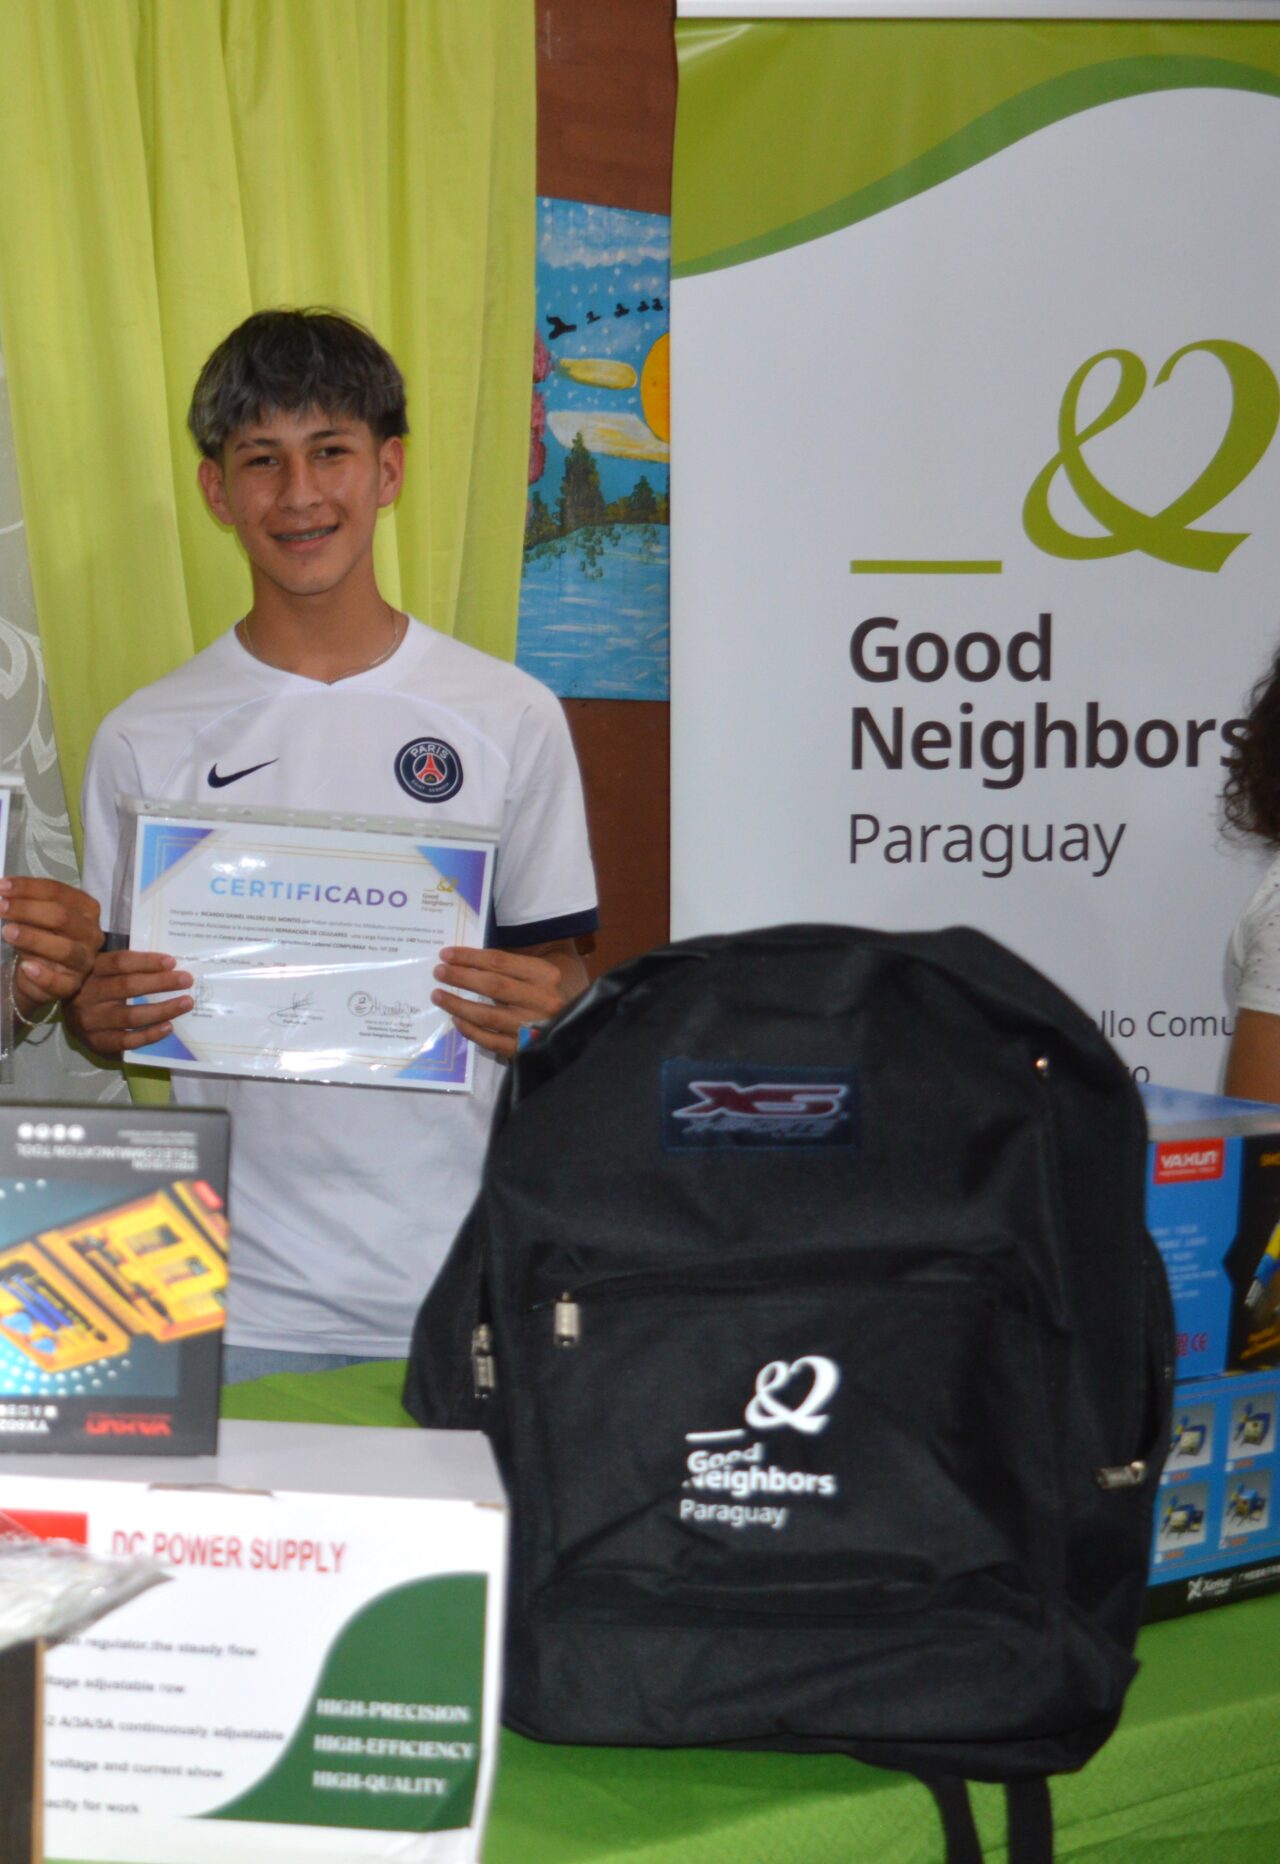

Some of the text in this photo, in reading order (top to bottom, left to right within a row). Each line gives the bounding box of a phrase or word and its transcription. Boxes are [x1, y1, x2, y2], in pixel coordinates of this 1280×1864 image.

[848, 612, 1053, 683] Good
[410, 744, 449, 759] PARIS
[848, 813, 1128, 879] Paraguay
[208, 875, 409, 909] CERTIFICADO
[1147, 1010, 1235, 1038] Comu
[687, 1442, 763, 1474] Good
[680, 1499, 788, 1530] Paraguay
[154, 1532, 244, 1569] POWER
[250, 1537, 346, 1573] SUPPLY
[316, 1699, 471, 1724] HIGH-PRECISION
[314, 1735, 474, 1759] HIGH-EFFICIENCY
[313, 1771, 447, 1797] HIGH-QUALITY
